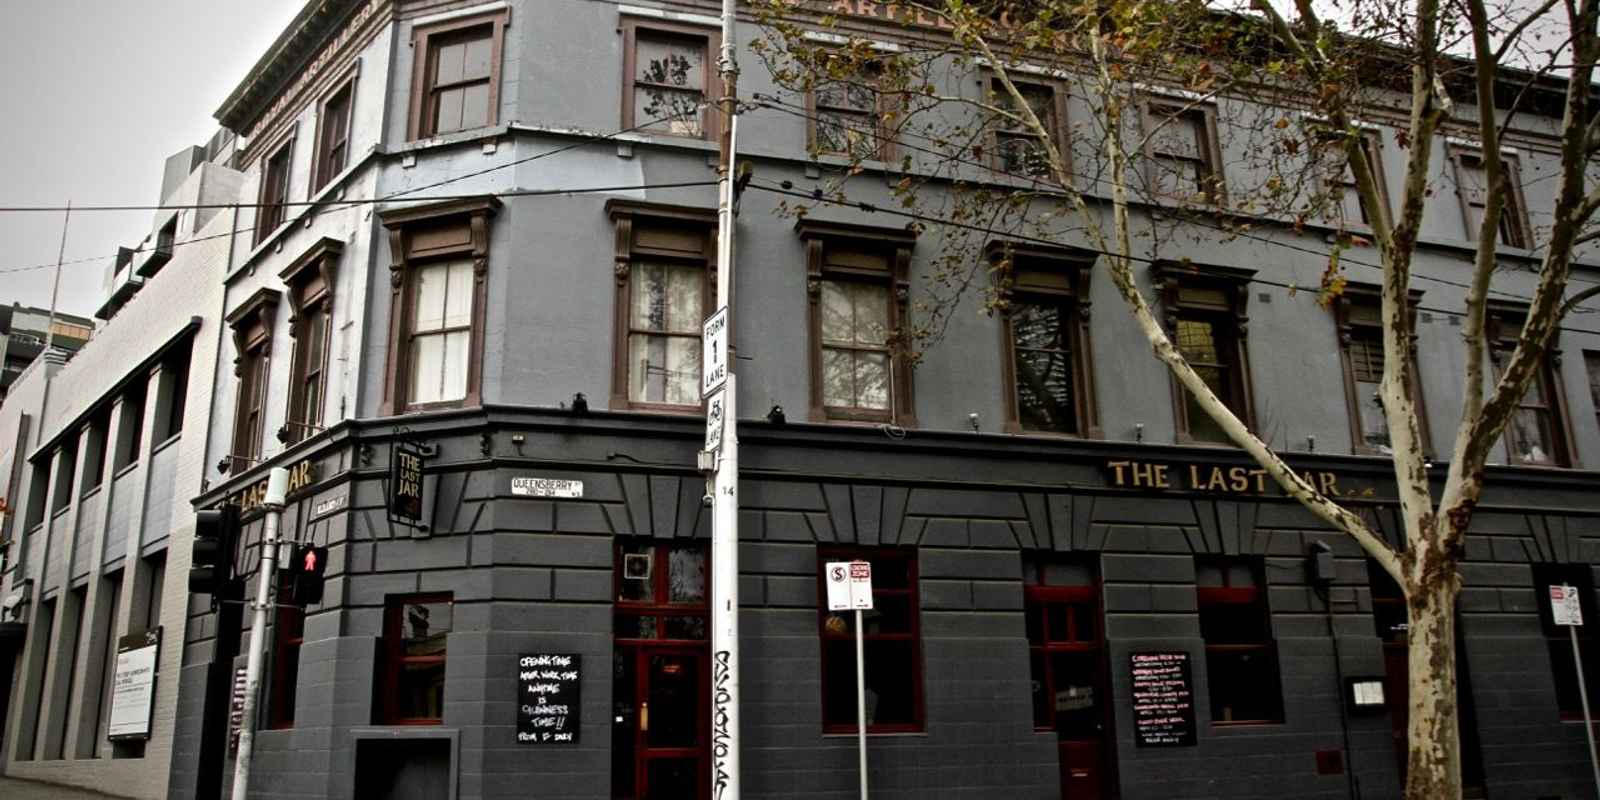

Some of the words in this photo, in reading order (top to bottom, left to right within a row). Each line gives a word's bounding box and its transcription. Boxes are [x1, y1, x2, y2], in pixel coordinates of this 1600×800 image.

[706, 314, 725, 340] FORM
[712, 340, 717, 364] 1
[706, 363, 724, 388] LANE
[399, 453, 420, 471] THE
[400, 469, 420, 482] LAST
[513, 479, 572, 491] QUEENSBERRY
[1107, 460, 1170, 488] THE
[1189, 464, 1269, 493] LAST
[397, 480, 419, 497] JAR
